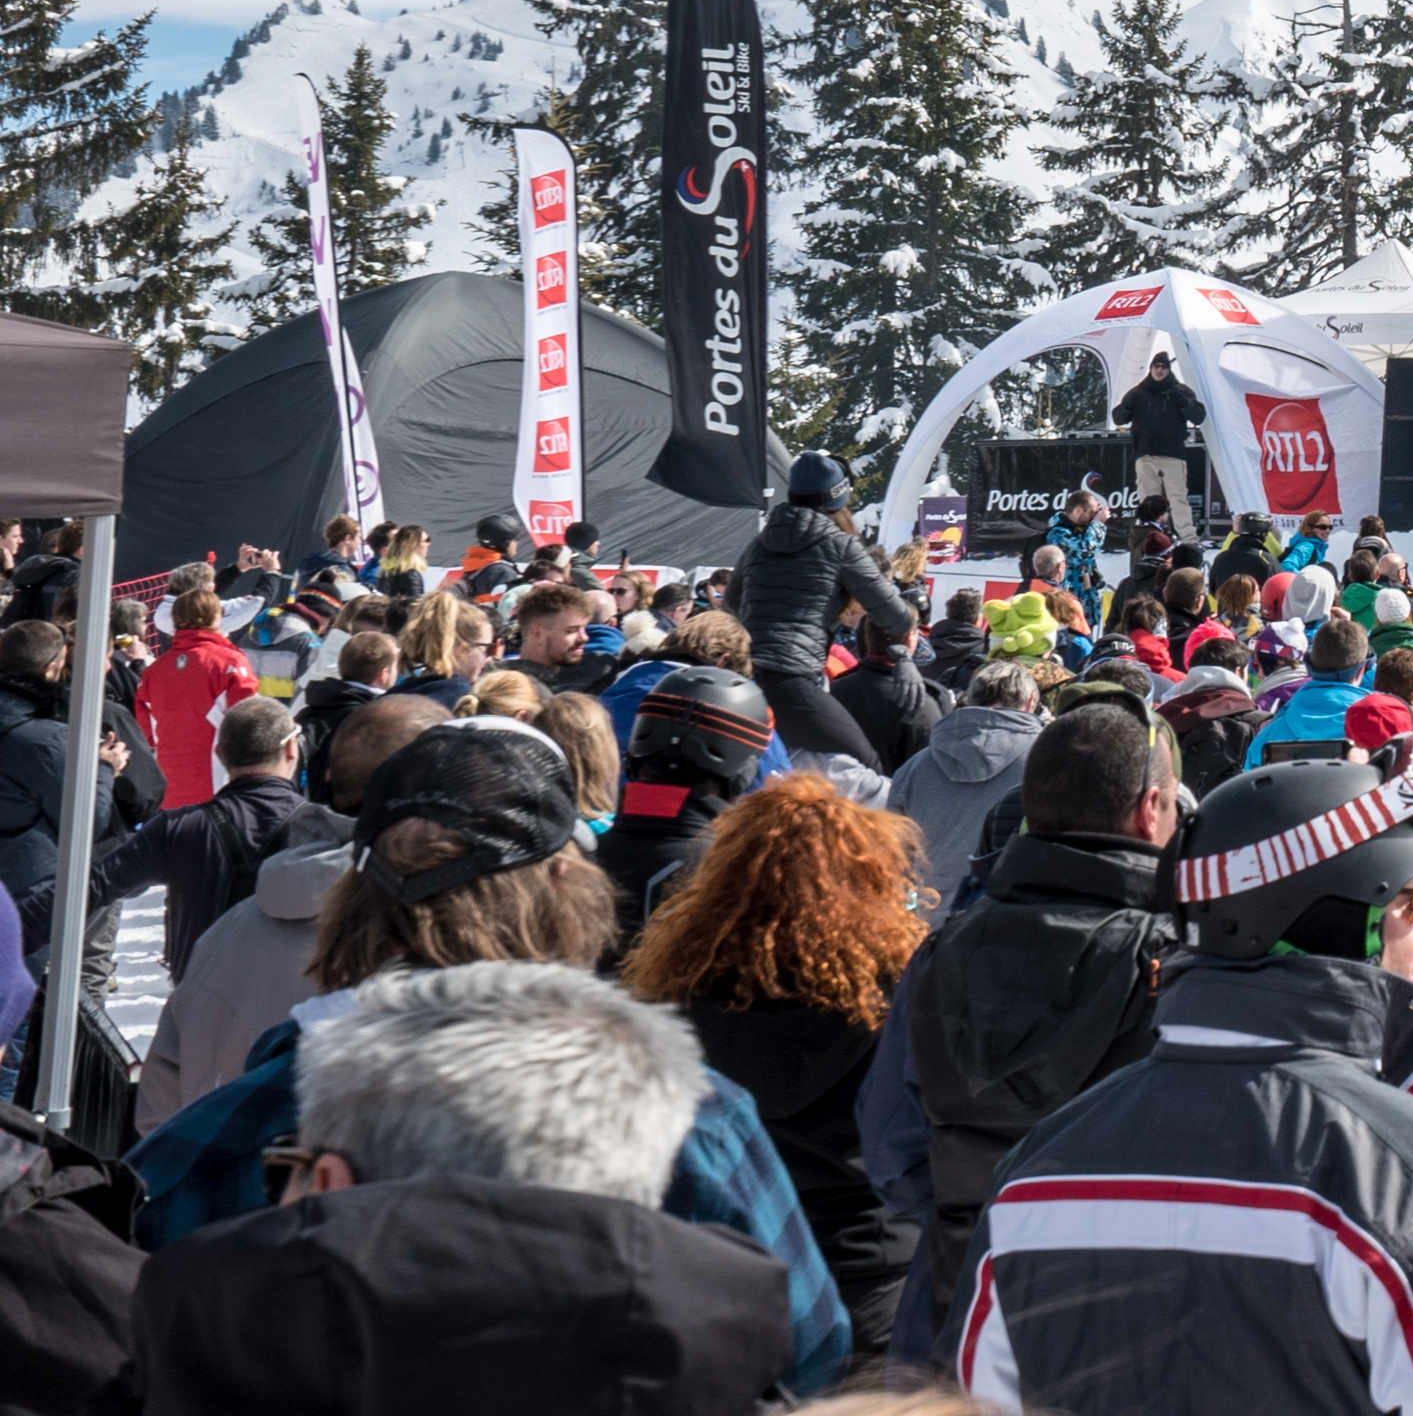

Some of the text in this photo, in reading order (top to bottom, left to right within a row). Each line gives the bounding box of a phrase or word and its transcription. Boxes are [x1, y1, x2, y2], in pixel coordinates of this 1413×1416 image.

[736, 42, 750, 113] Ski & Bike
[676, 43, 757, 436] Portes du Soleil
[1106, 293, 1155, 310] RTL2
[1209, 297, 1247, 313] RTL2
[1326, 315, 1364, 341] Soleil
[1263, 430, 1330, 473] RTL2
[987, 471, 1140, 512] Portes d Sole
[1280, 518, 1296, 528] SON
